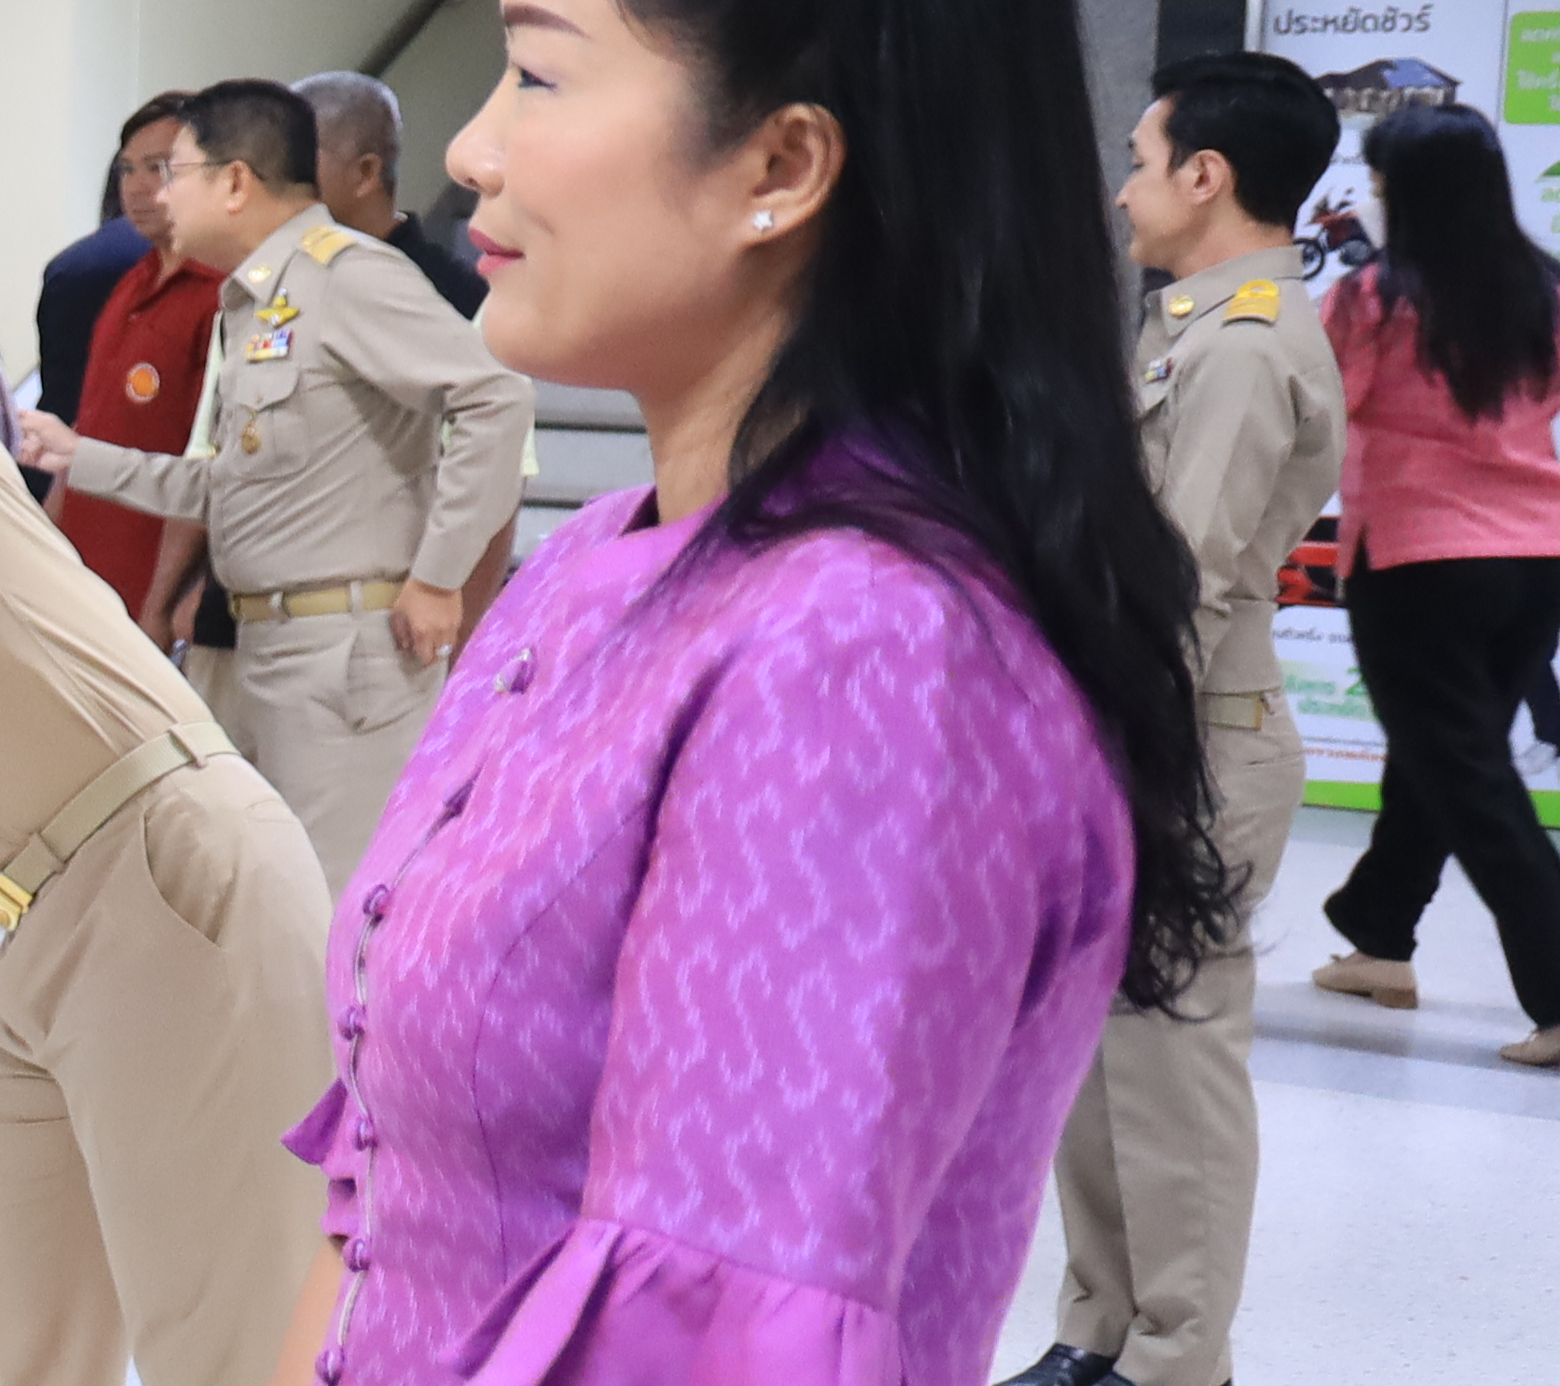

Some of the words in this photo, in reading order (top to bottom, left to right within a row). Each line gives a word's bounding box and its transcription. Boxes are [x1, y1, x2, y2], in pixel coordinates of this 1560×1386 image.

[1274, 3, 1434, 36] ประหยัดชัวร์
